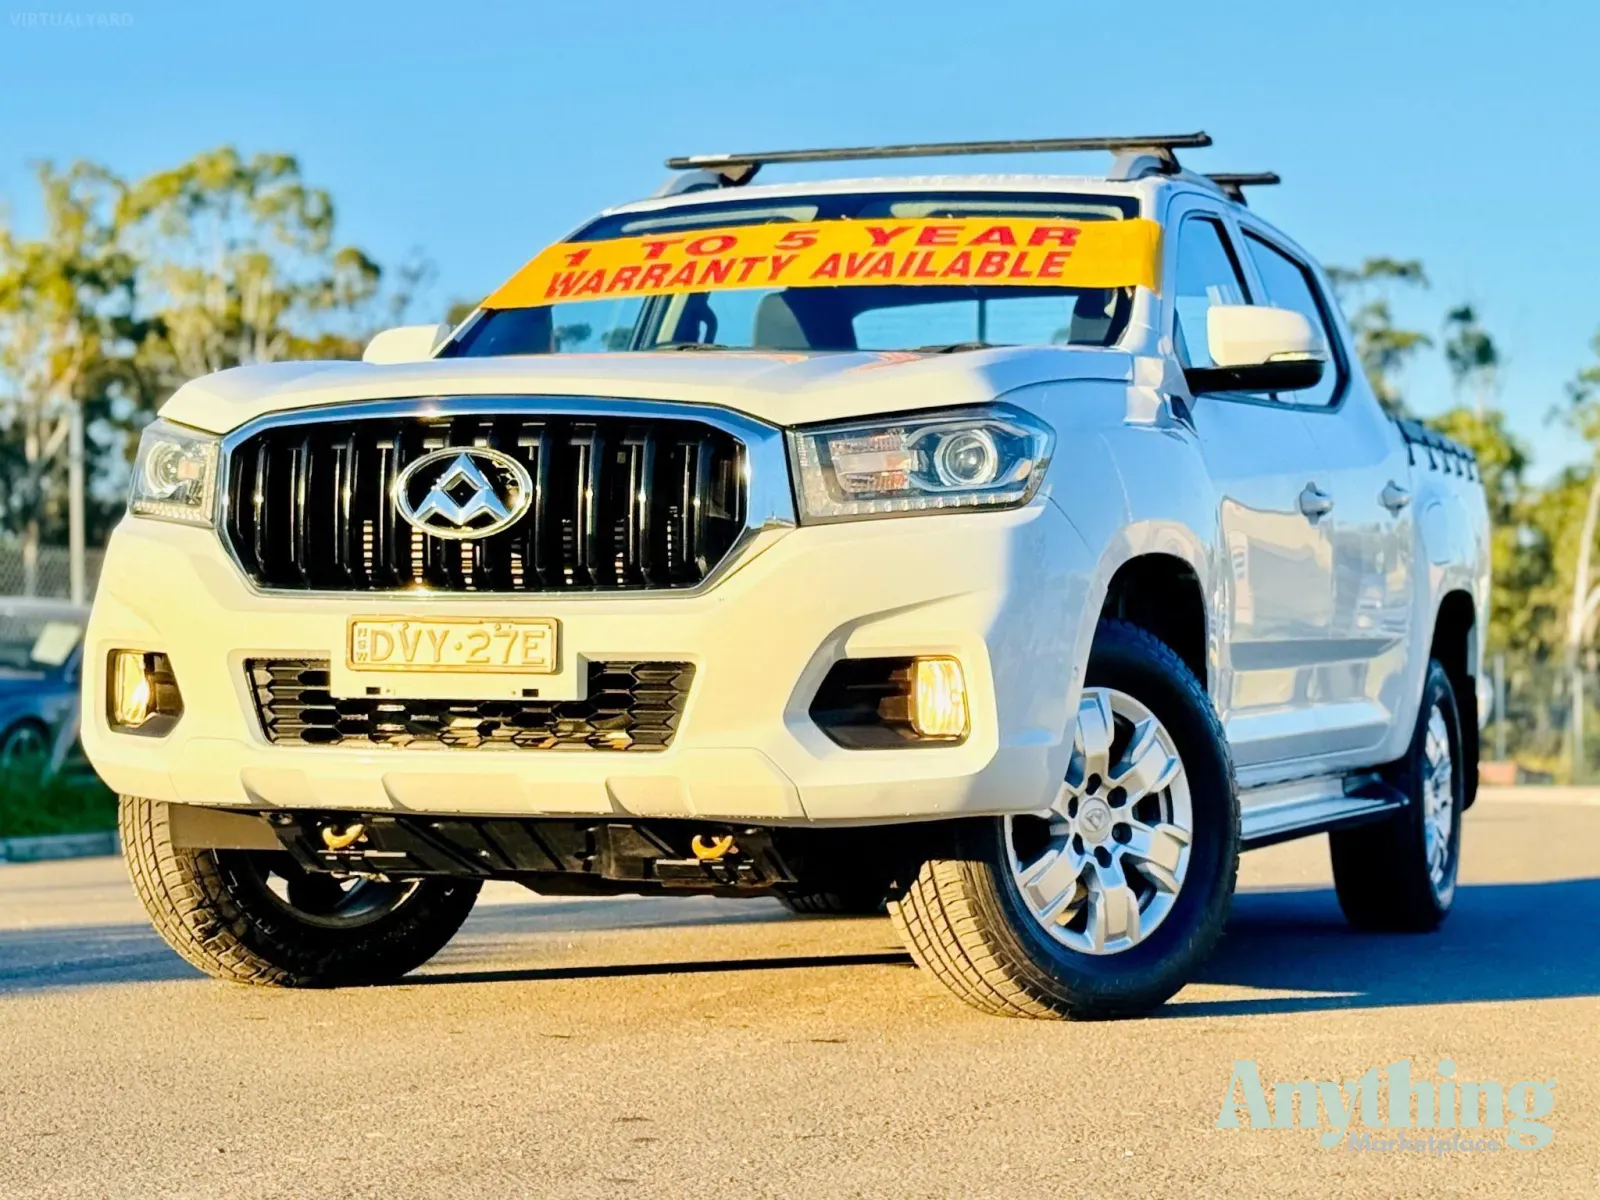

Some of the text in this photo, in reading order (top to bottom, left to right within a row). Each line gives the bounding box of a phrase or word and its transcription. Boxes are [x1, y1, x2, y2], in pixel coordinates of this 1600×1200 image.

[564, 226, 1082, 268] 1 TO 5 YEAR
[543, 250, 1073, 299] WARRANTY AVAILABLE
